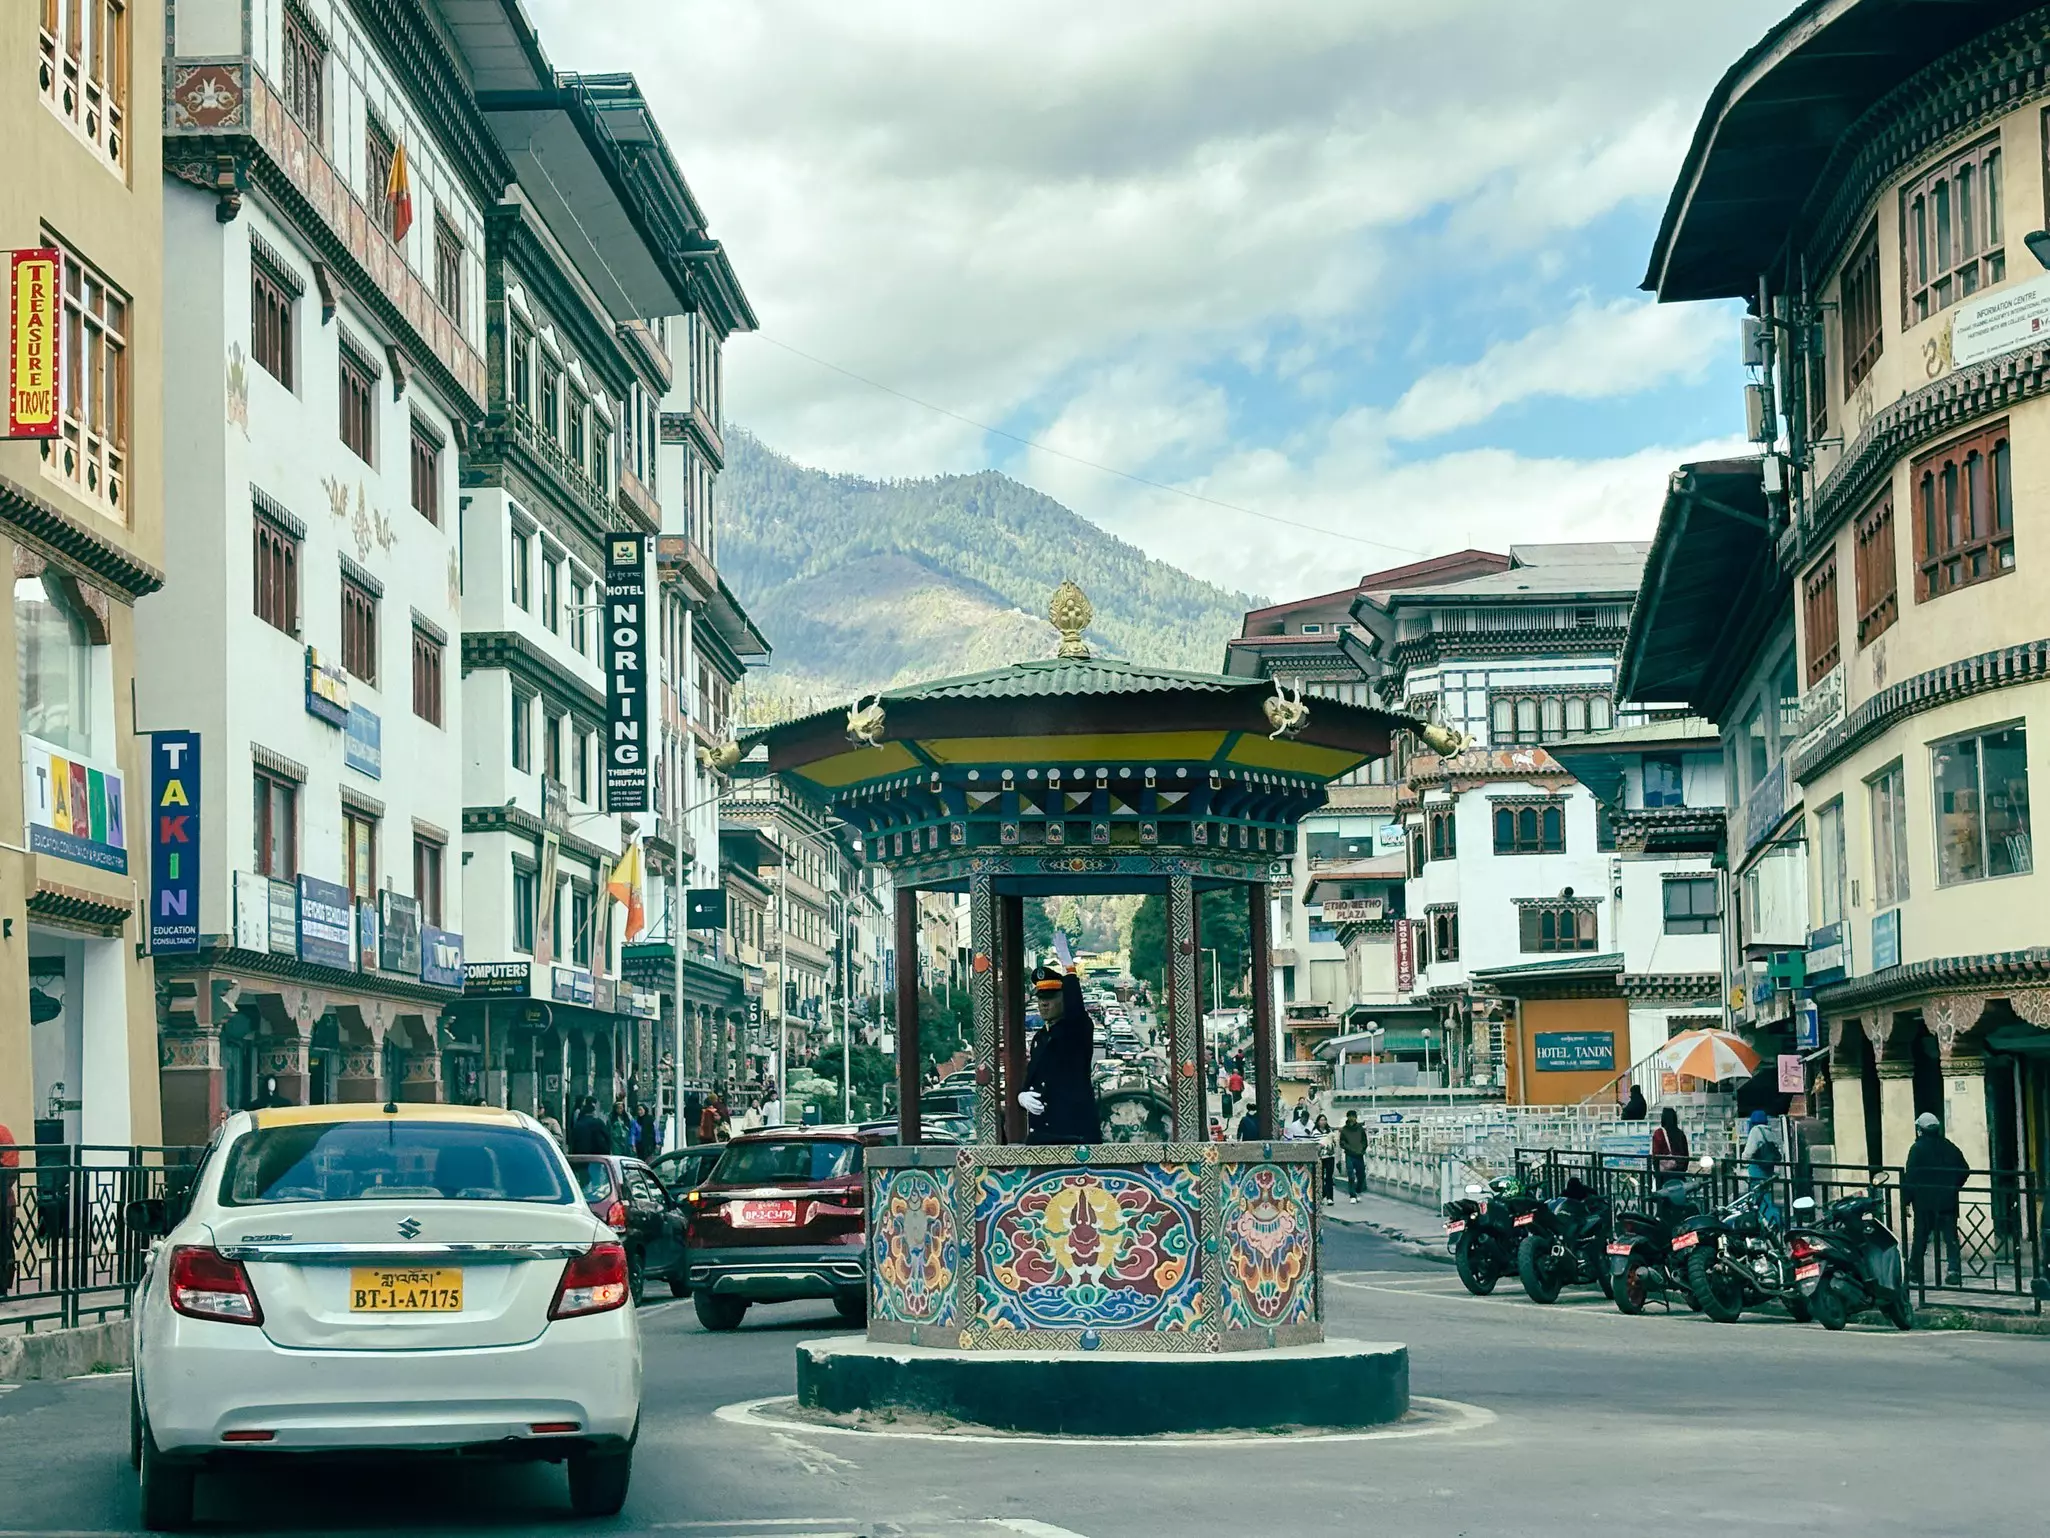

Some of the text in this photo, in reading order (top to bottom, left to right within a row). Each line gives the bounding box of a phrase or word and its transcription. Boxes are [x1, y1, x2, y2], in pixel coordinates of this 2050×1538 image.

[1977, 291, 2037, 318] INFORMATION CENTRE
[26, 265, 46, 386] TREASURE
[19, 390, 50, 416] TROVE
[606, 585, 644, 596] HOTEL
[613, 604, 639, 764] NORLING
[608, 779, 645, 787] BHUTAN
[160, 743, 189, 916] TAKIN
[1337, 910, 1367, 920] PLAZA
[153, 926, 196, 935] EDUCATION
[153, 937, 196, 946] CONSULTANCY
[463, 964, 528, 979] COMPUTERS
[1537, 1046, 1612, 1058] HOTEL TANDIN
[354, 1289, 460, 1308] BT-1-A7175
